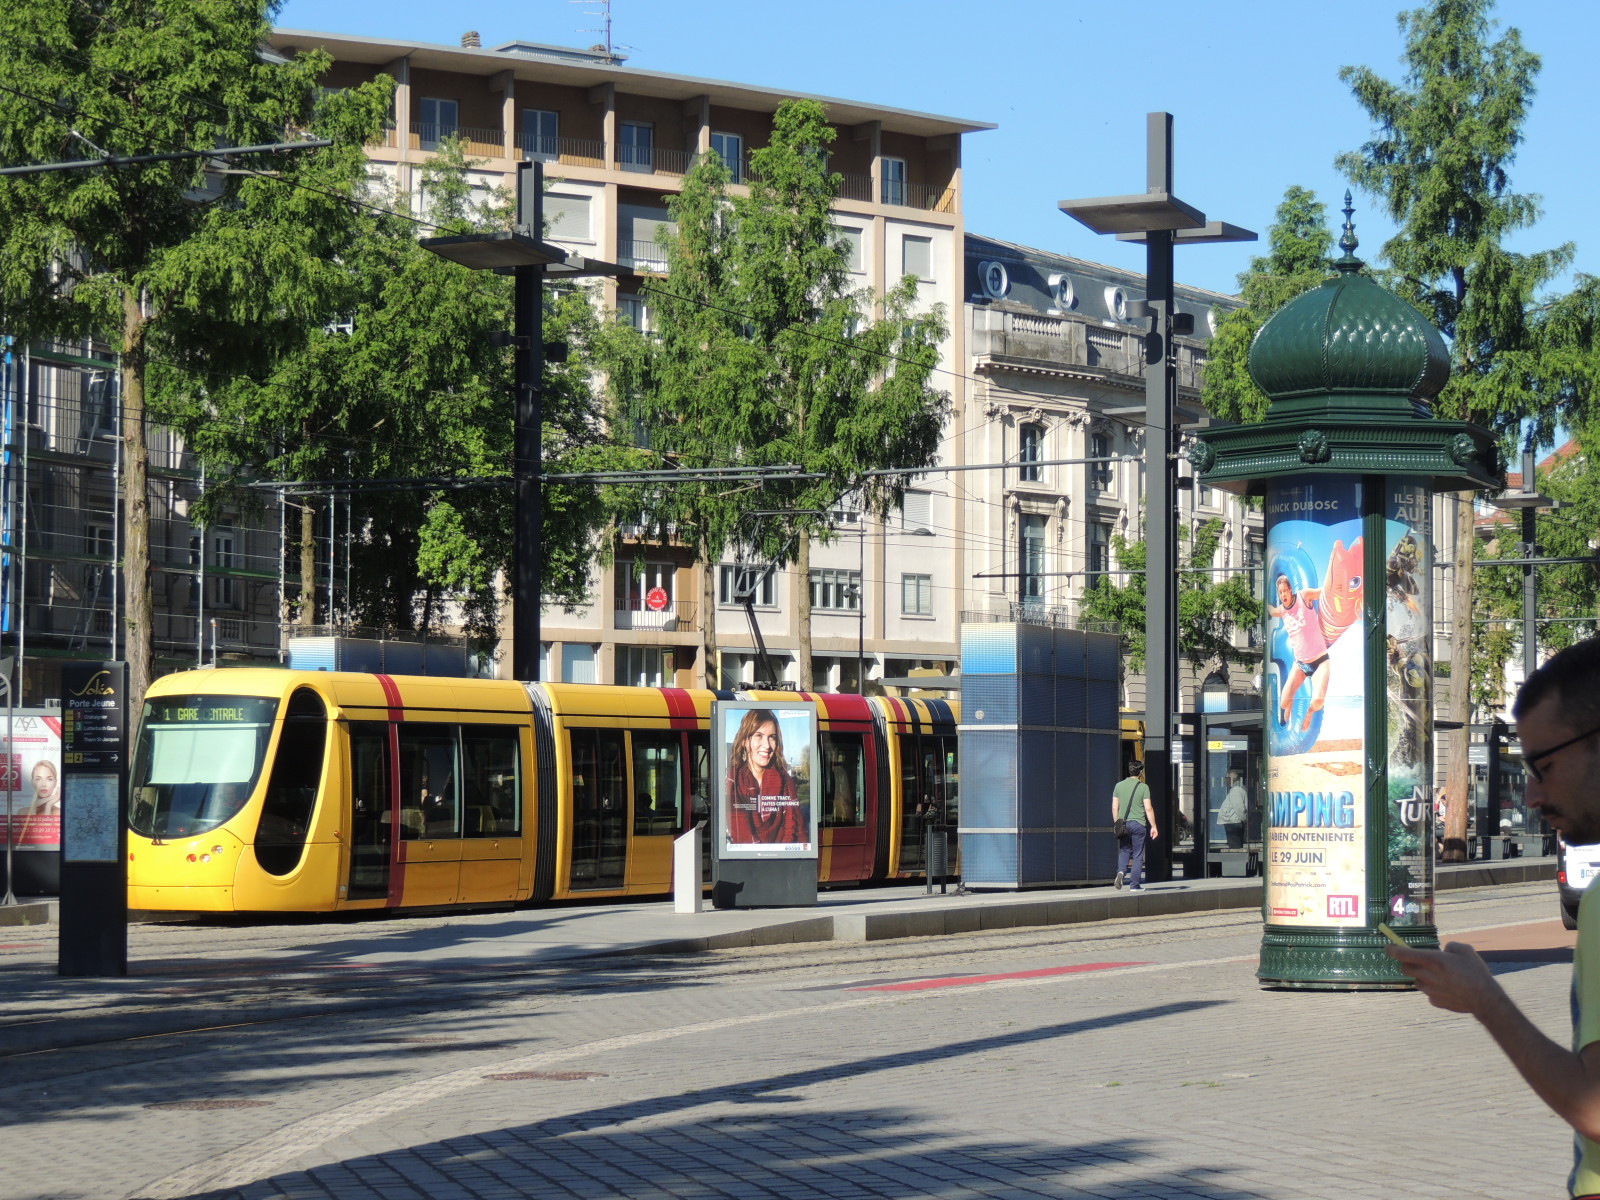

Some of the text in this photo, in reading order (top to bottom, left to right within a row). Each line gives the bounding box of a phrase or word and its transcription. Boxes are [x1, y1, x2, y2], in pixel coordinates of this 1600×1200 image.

[1394, 493, 1414, 504] ILS
[1293, 500, 1338, 511] DUBOSC
[164, 708, 171, 720] 1
[178, 707, 199, 720] GARE
[1291, 832, 1355, 842] ONTENIENTE
[1272, 852, 1323, 864] LE 29 JUIN
[1329, 897, 1357, 916] RTL
[1393, 897, 1405, 915] 4
